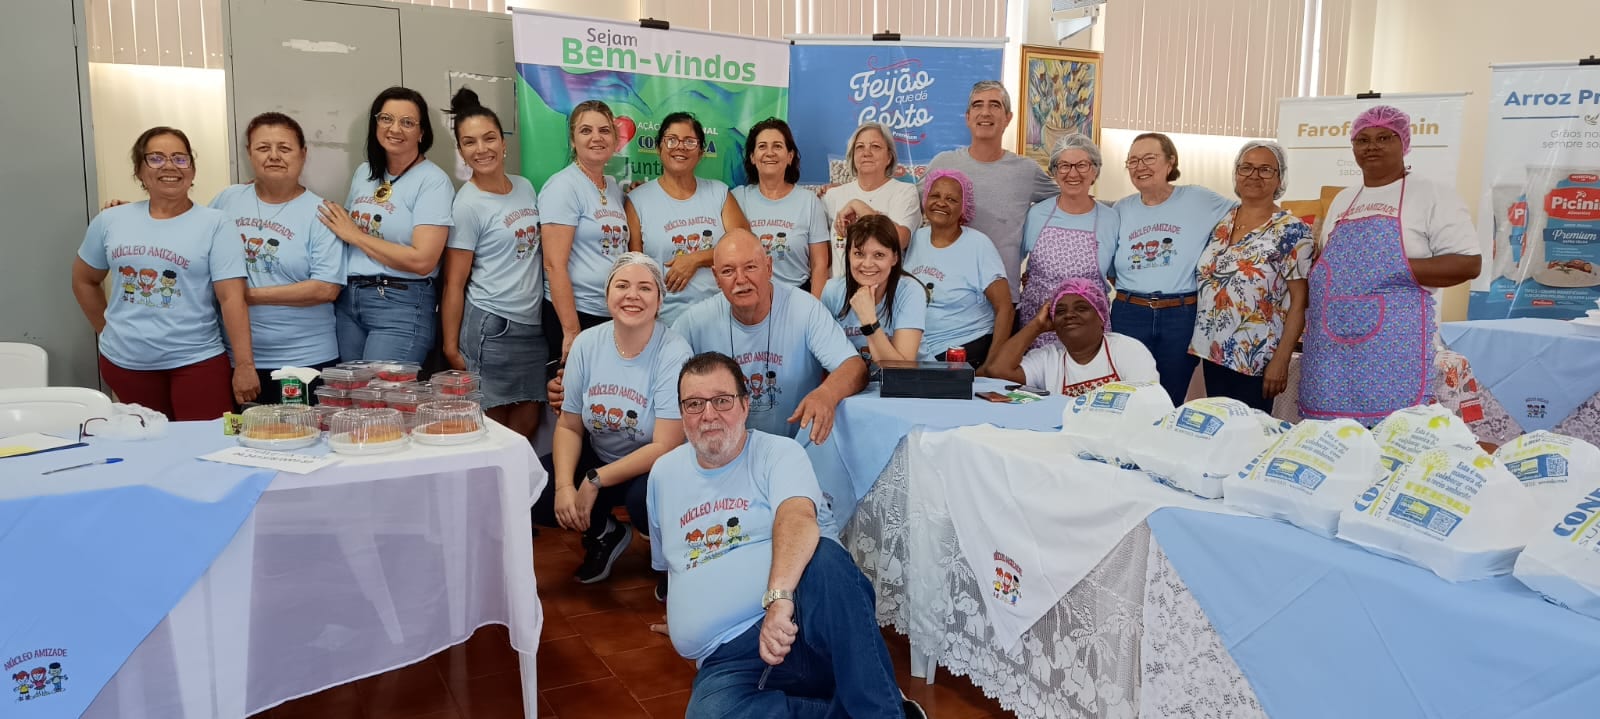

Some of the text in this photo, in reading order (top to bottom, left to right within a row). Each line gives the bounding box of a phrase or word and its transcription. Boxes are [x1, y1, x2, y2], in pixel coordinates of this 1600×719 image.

[586, 27, 638, 47] Sejam
[561, 37, 757, 82] Bem-vindos
[849, 68, 935, 112] Feijão
[895, 90, 928, 104] que dá
[1504, 91, 1572, 107] Arroz
[858, 104, 934, 130] Gosto
[1297, 121, 1352, 137] Farof
[624, 157, 664, 177] Junt
[1551, 229, 1598, 241] Premium
[112, 243, 190, 270] NÚCLEO AMIZADE
[588, 382, 649, 408] NÚCLEO AMIZADE
[680, 501, 712, 528] NÚCLEO
[3, 647, 68, 671] NÚCLEO AMIZADE
